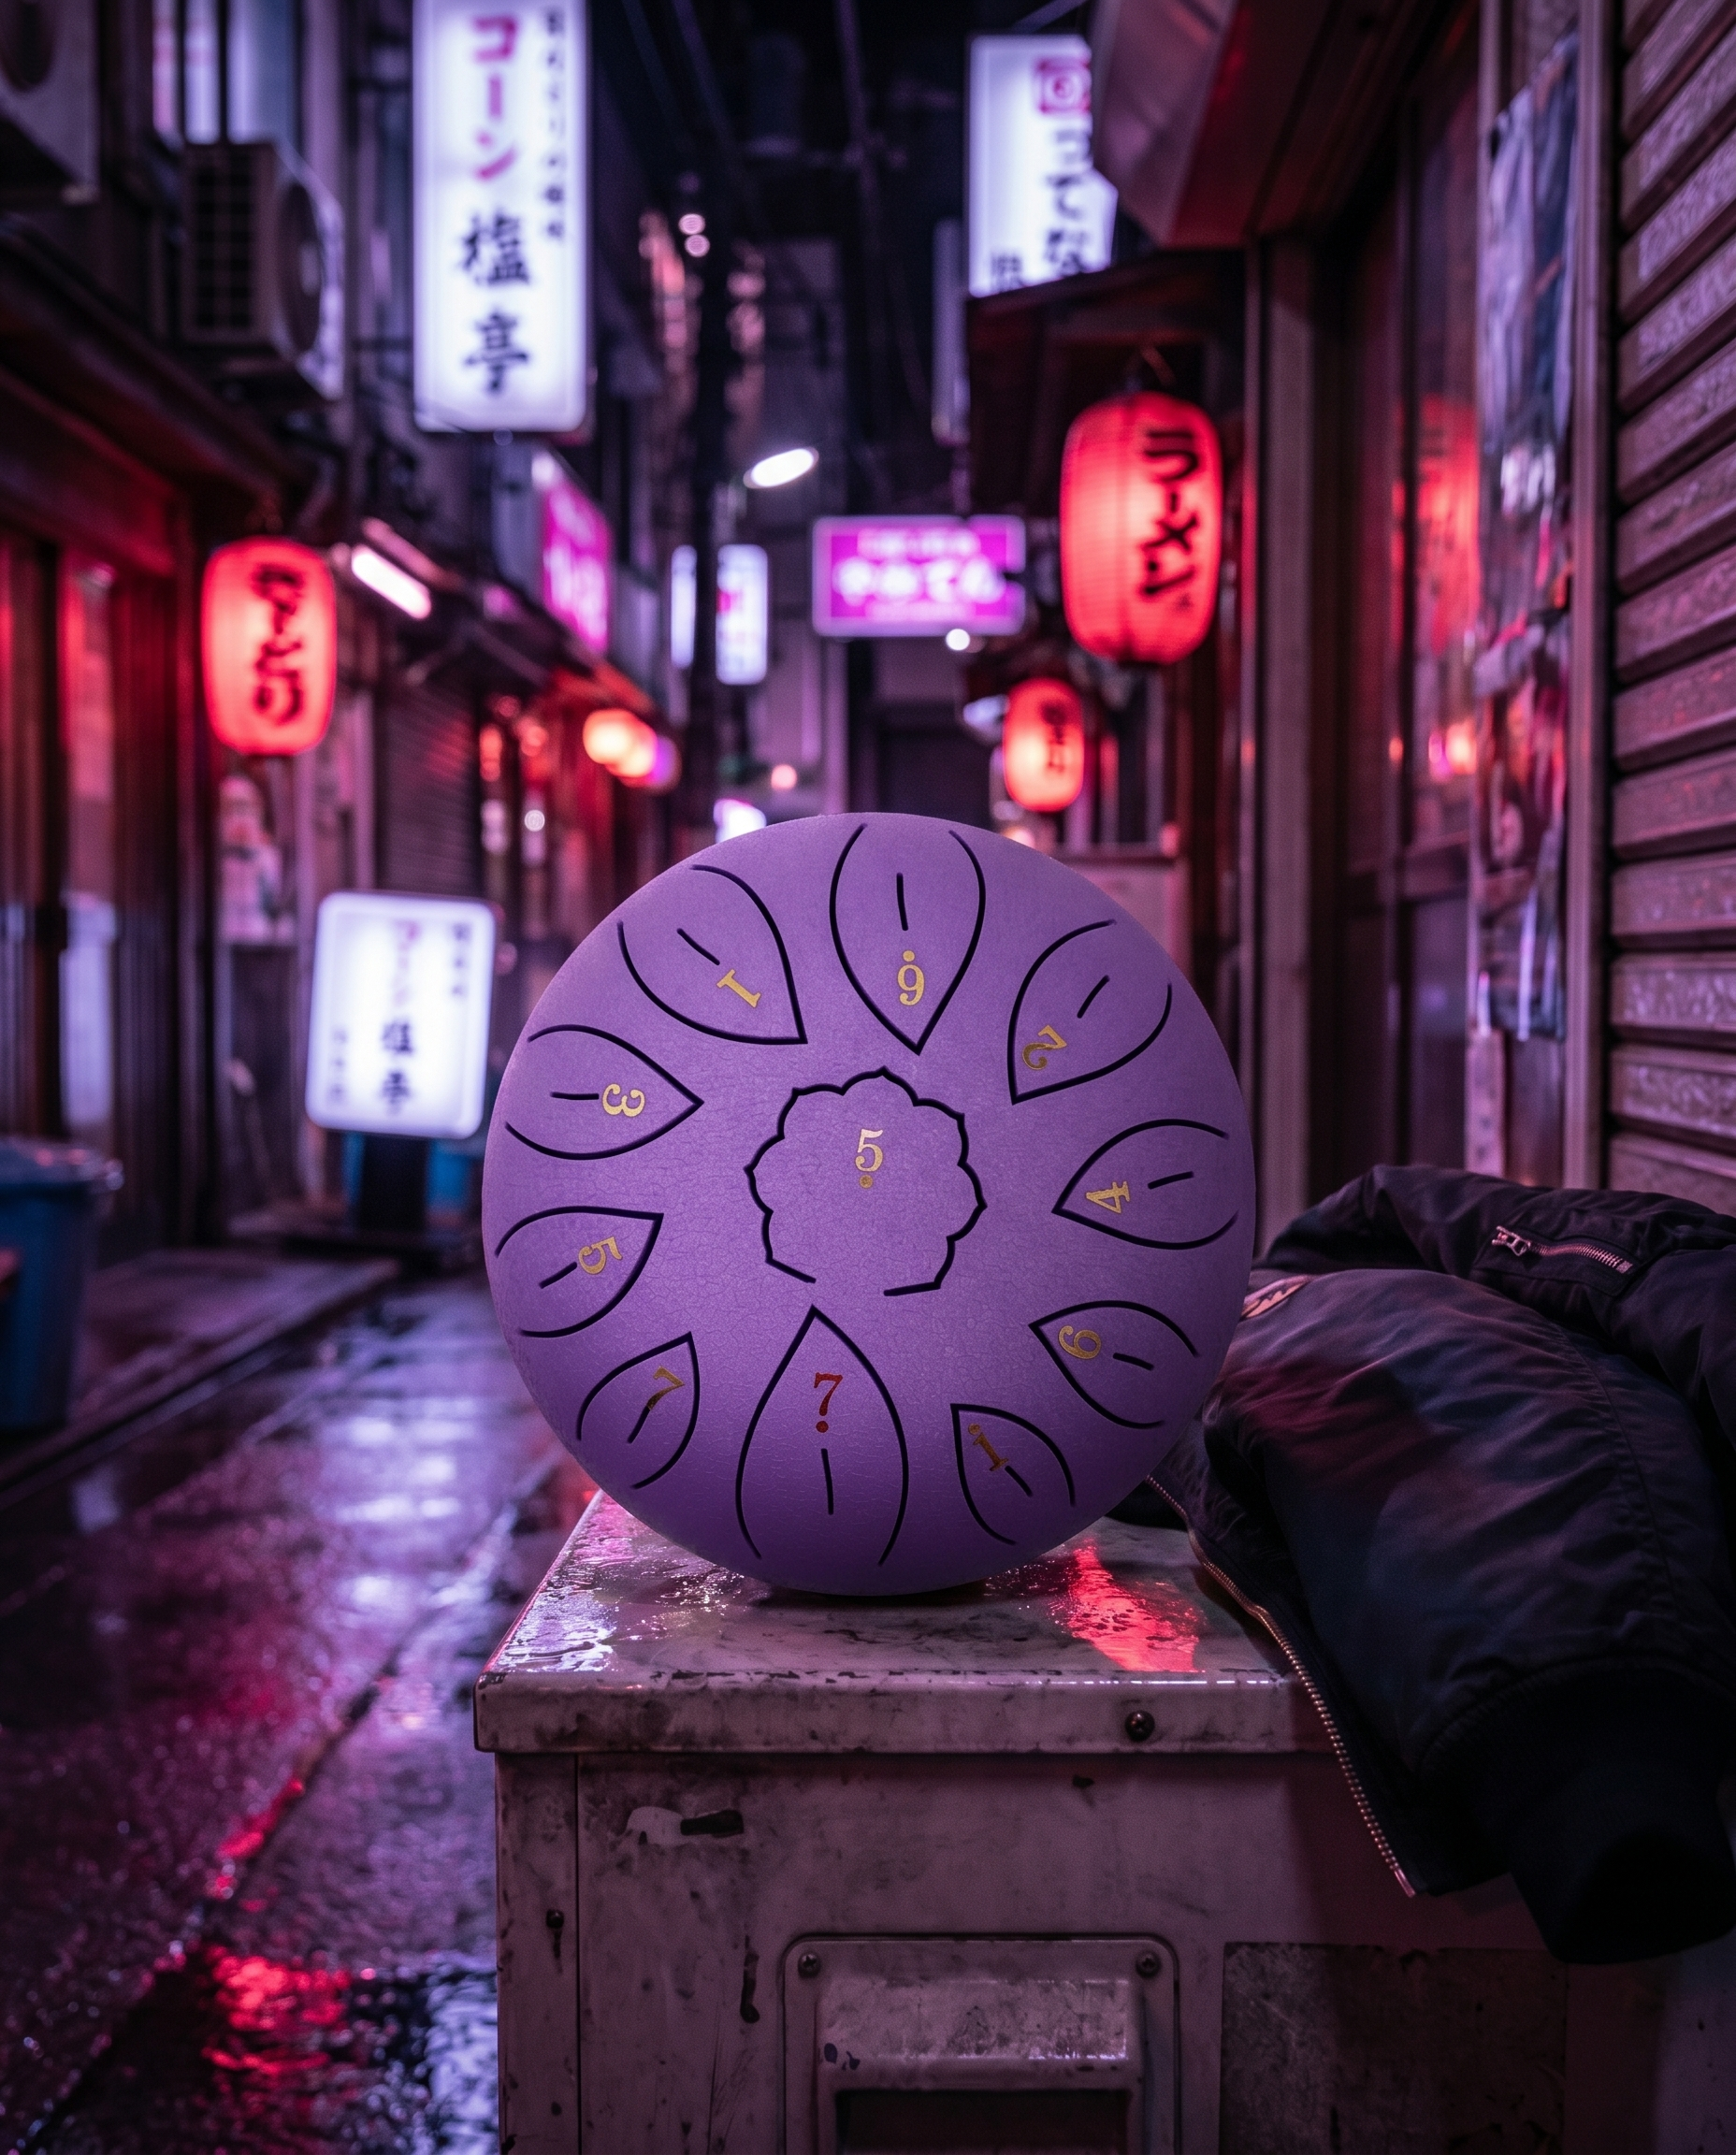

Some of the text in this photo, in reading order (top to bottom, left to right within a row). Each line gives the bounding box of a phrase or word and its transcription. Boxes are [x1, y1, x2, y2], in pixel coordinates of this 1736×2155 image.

[716, 968, 762, 1009] 1
[1020, 1024, 1068, 1071] 2
[601, 1082, 646, 1118] 3
[1084, 1179, 1132, 1215] 4
[577, 1236, 623, 1276] 5
[645, 1365, 686, 1411] 7
